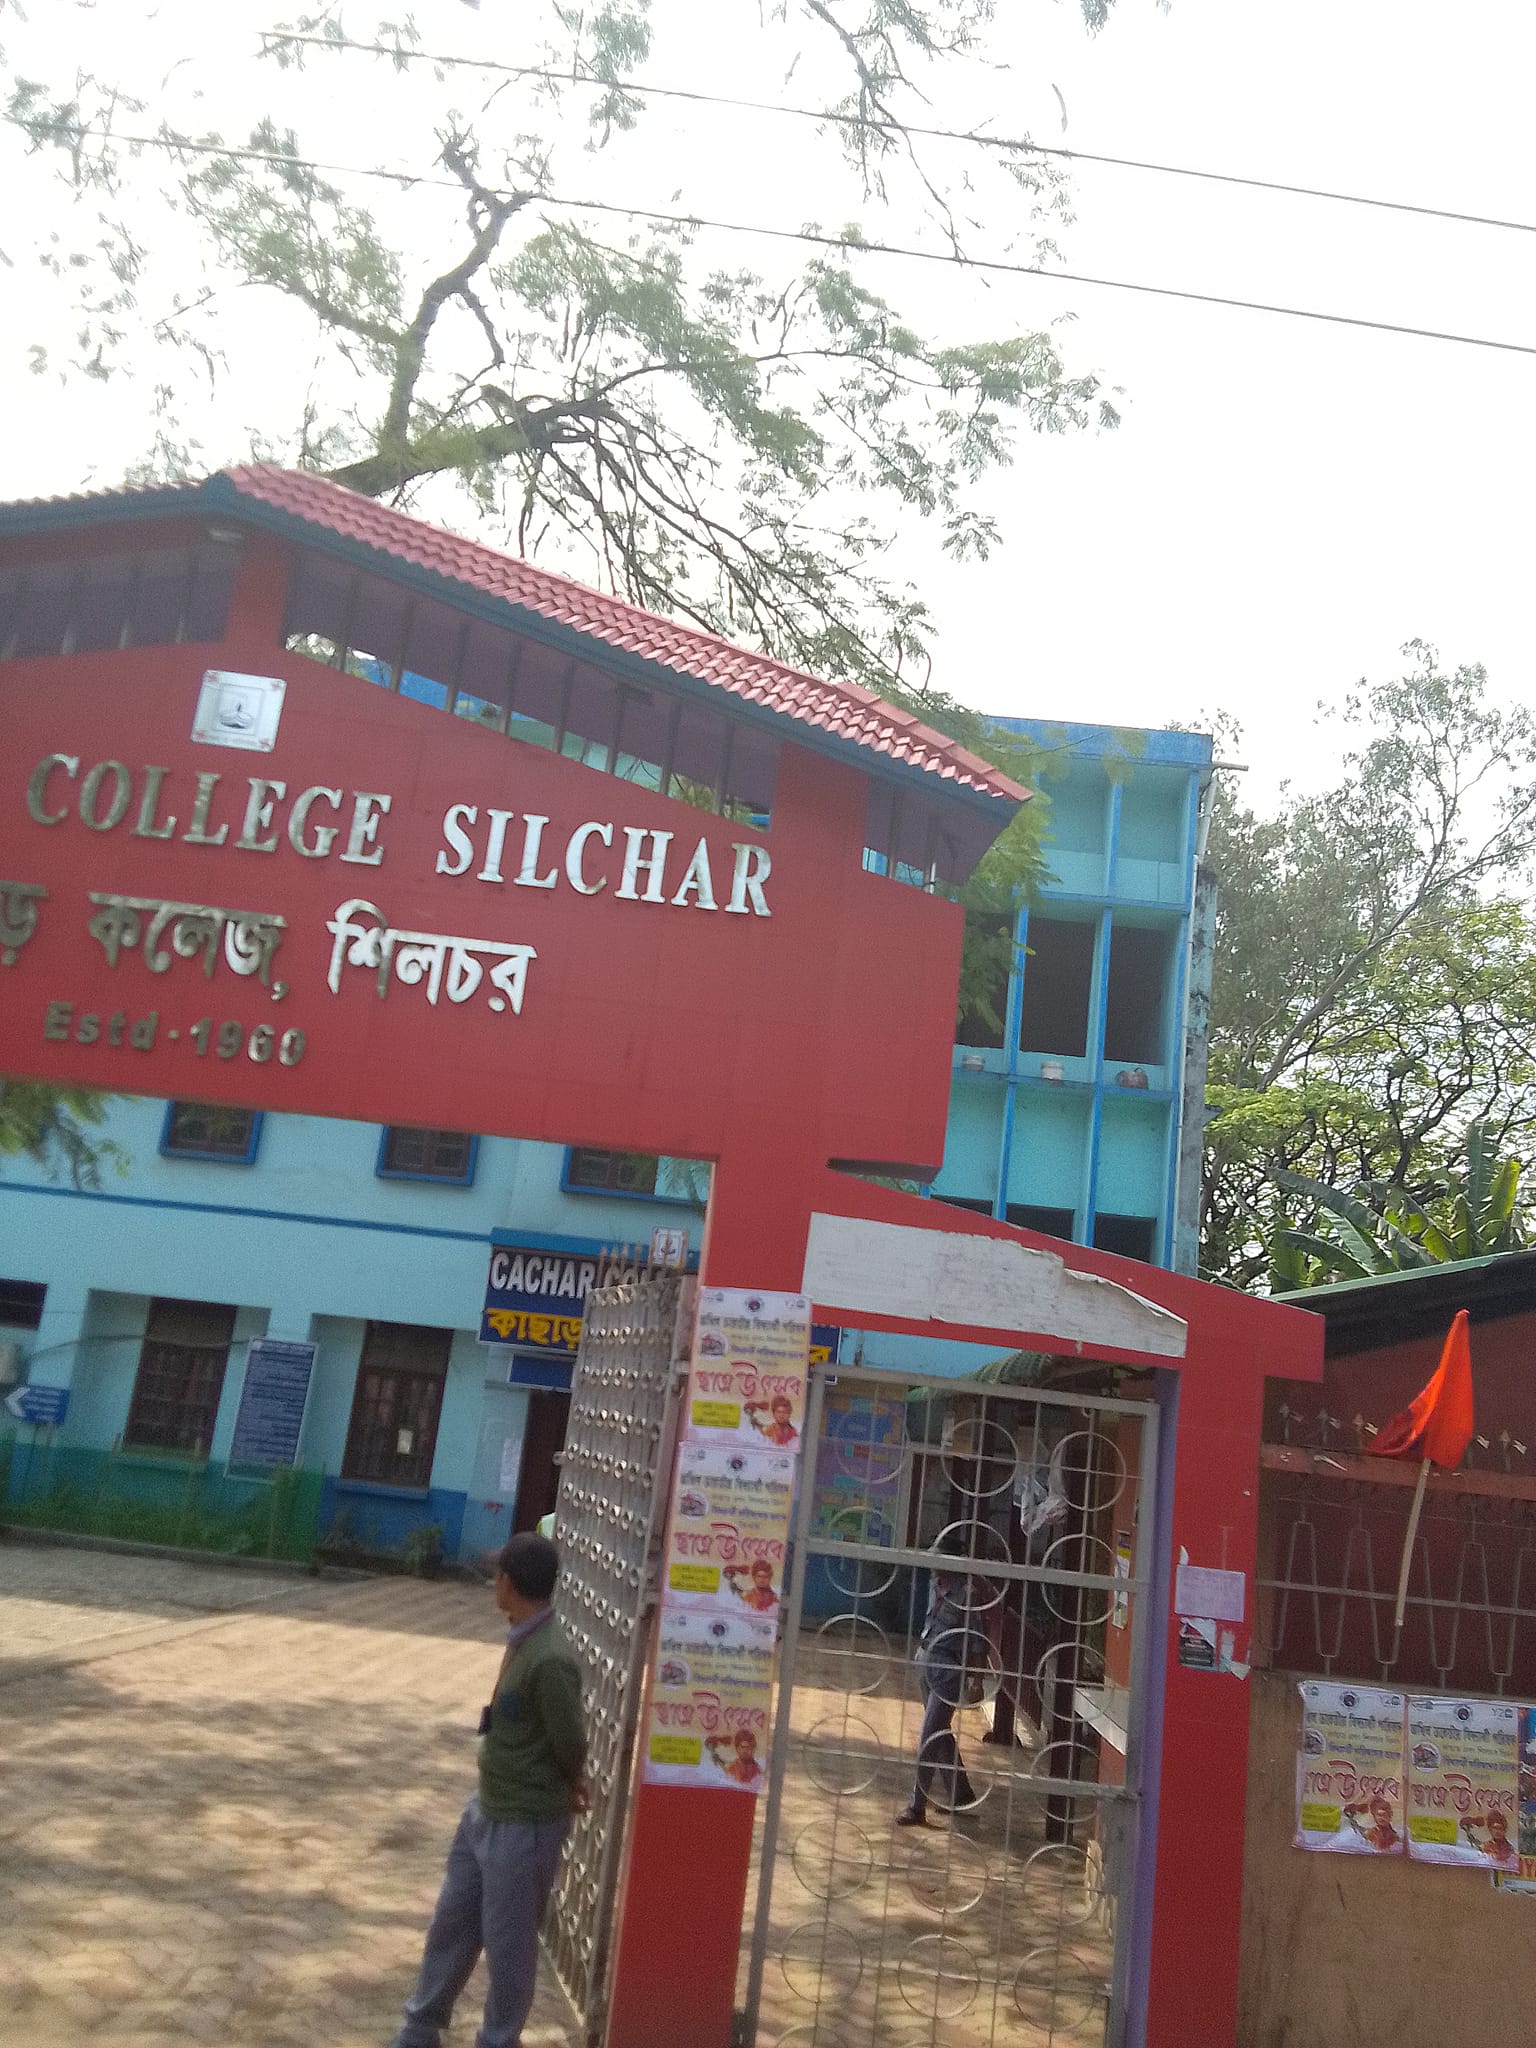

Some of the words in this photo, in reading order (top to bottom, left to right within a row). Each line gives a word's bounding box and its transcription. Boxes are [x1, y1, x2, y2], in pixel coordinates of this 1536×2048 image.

[27, 752, 391, 867] COLLEGE
[435, 802, 774, 917] SILCHAR
[327, 898, 537, 1015] শিলচর
[490, 1252, 596, 1300] CACHAR
